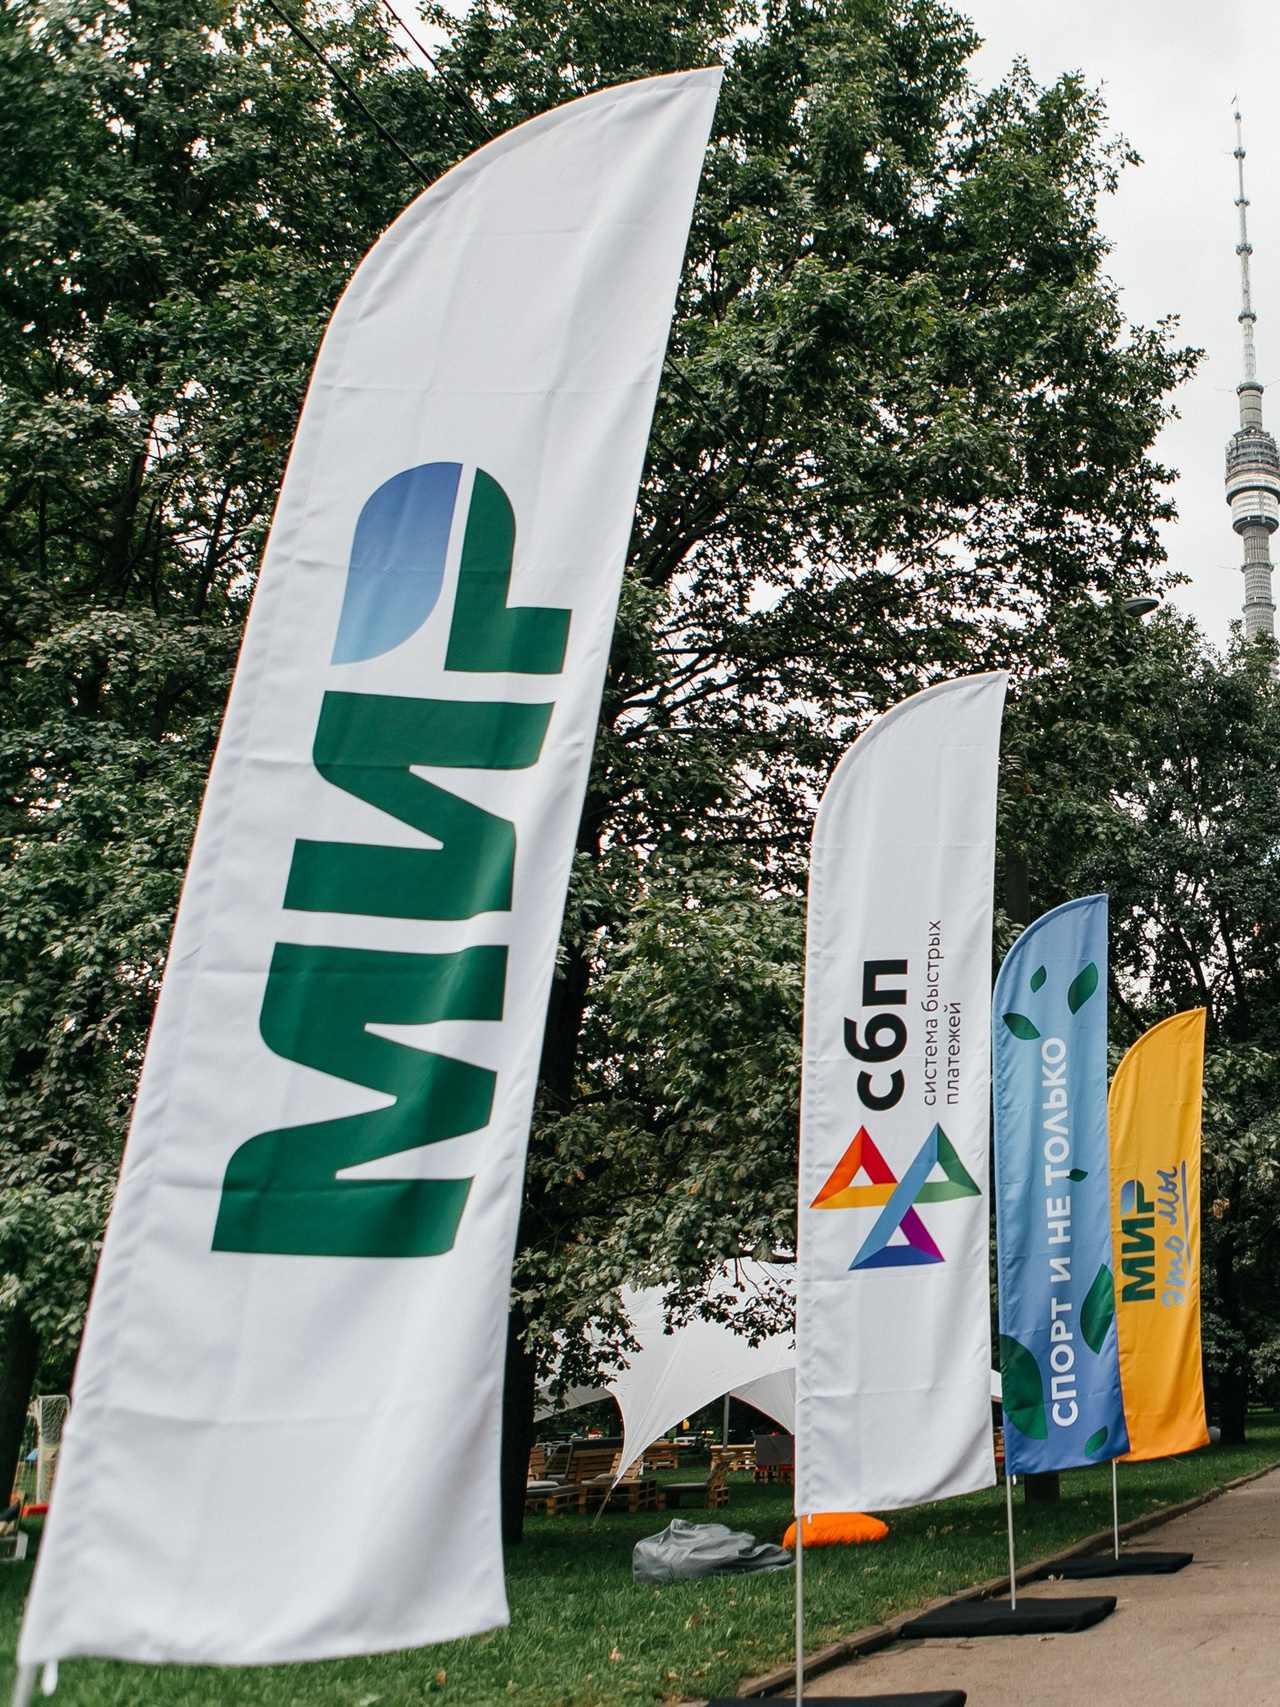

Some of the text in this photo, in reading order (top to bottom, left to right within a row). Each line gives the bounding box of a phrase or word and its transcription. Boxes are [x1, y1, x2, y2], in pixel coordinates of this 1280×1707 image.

[211, 461, 572, 1258] МИР
[921, 920, 945, 1106] система быстрых
[943, 1002, 962, 1105] платежей
[1041, 1037, 1079, 1427] СПОРТ И НЕ ТОЛЬКО
[1120, 1179, 1155, 1303] МИР
[1156, 1165, 1180, 1226] мы
